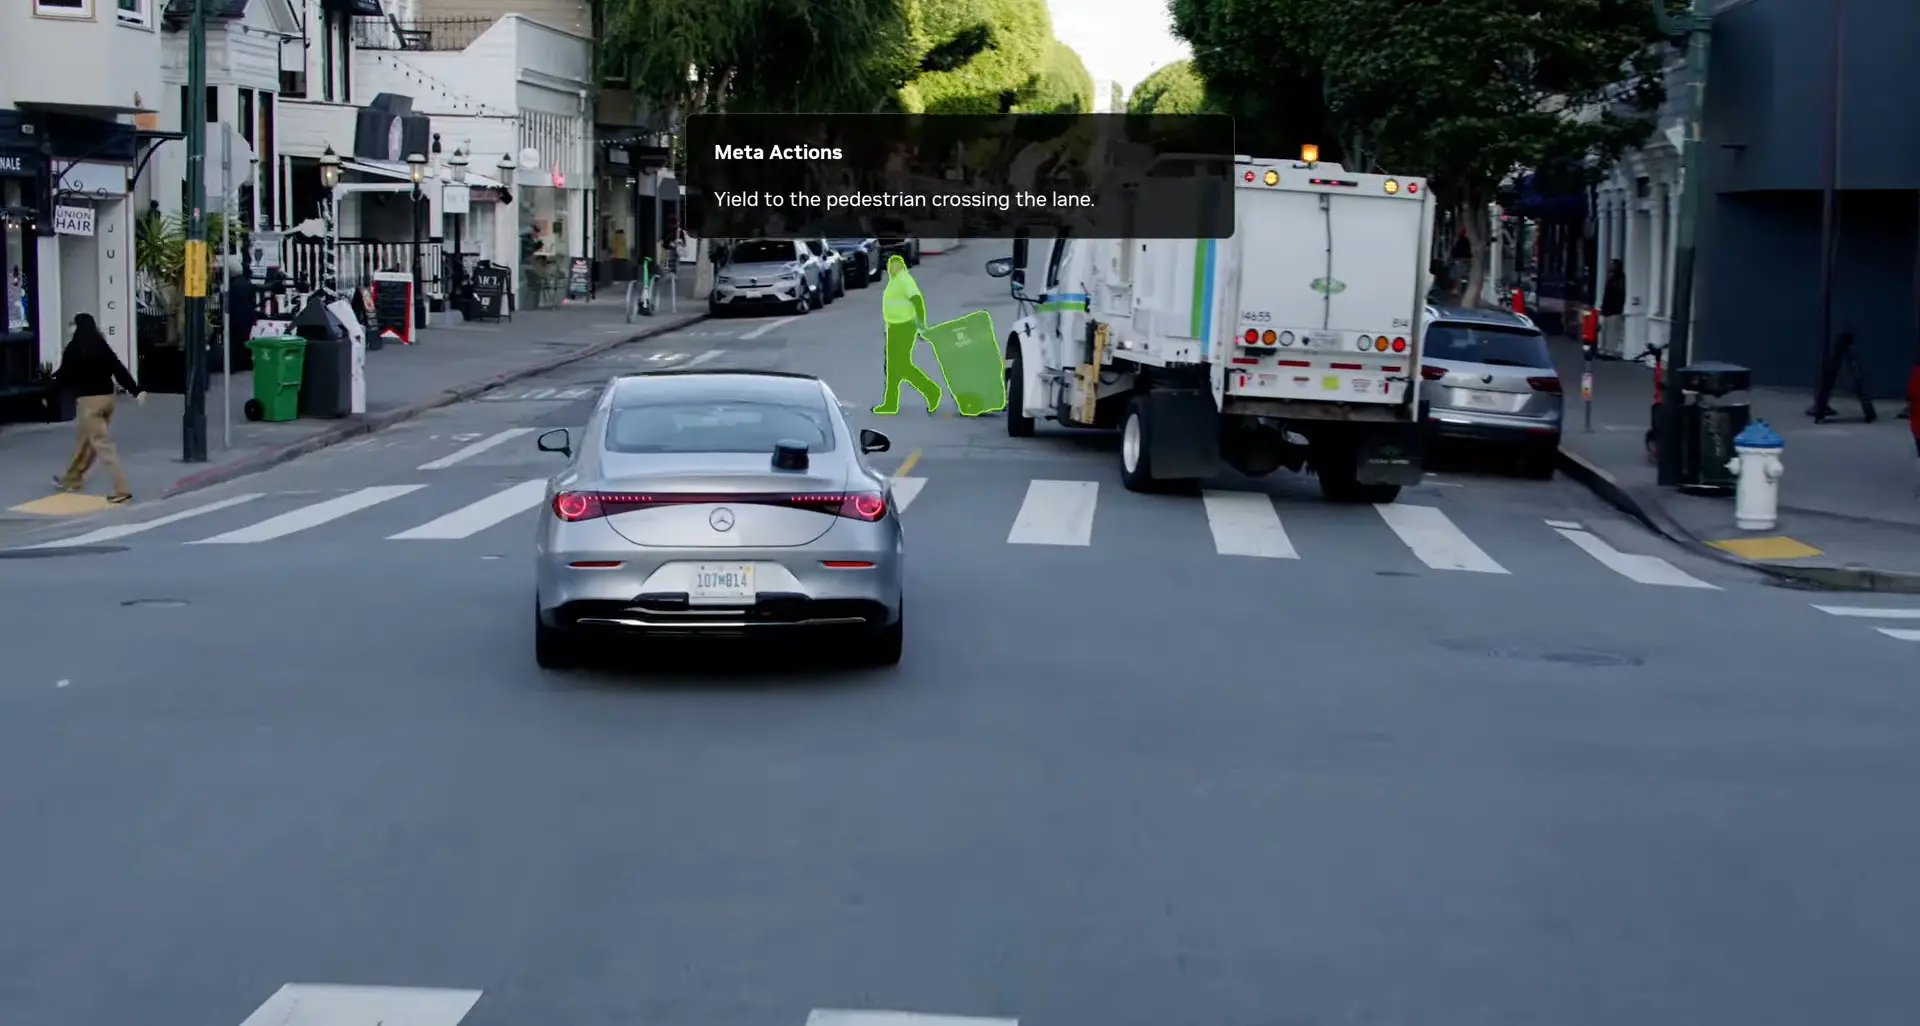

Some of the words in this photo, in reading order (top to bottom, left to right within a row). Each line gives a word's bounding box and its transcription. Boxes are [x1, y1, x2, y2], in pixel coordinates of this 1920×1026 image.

[56, 208, 91, 220] UNION
[56, 217, 91, 232] HAIR
[106, 223, 116, 336] JUICE
